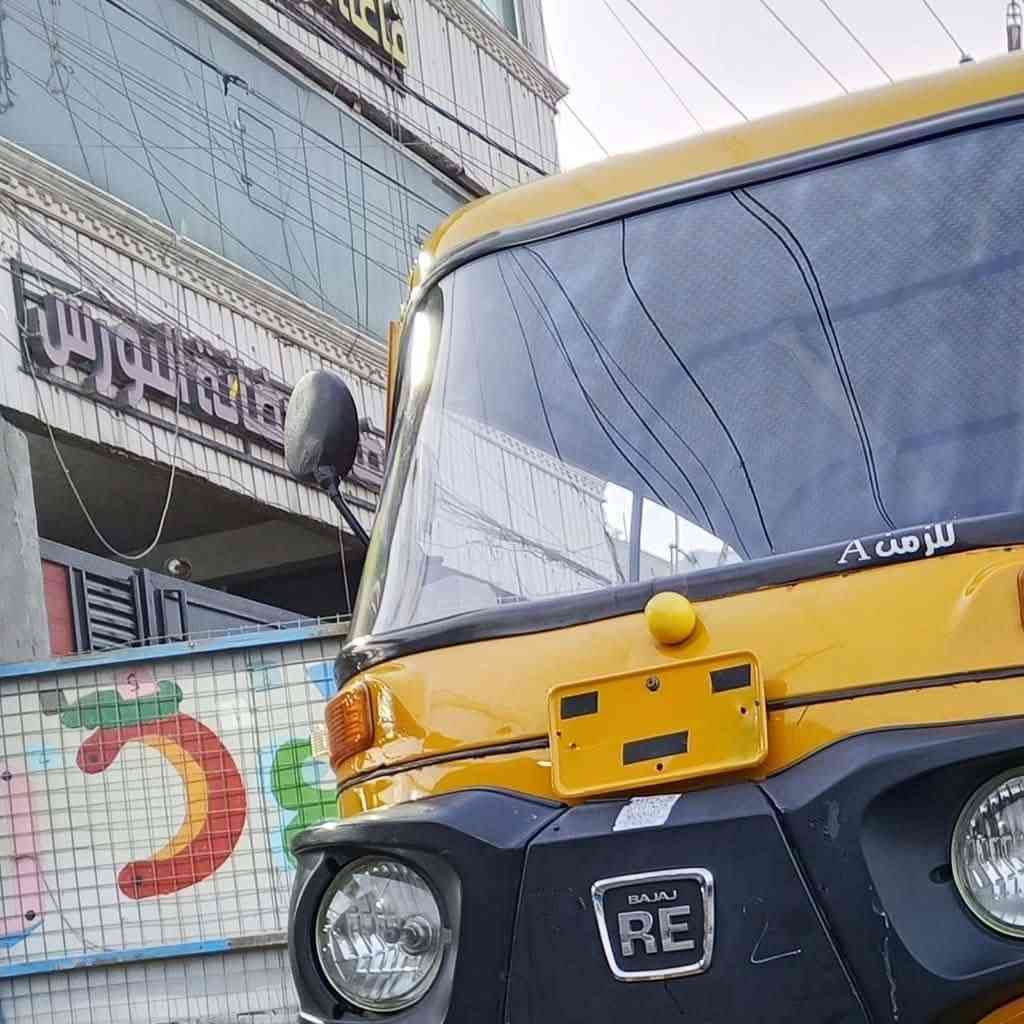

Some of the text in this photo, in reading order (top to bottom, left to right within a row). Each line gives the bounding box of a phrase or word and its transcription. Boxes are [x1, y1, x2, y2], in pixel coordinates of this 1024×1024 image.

[837, 539, 871, 564] A
[627, 889, 677, 905] BAJAJ
[617, 905, 695, 957] RE
